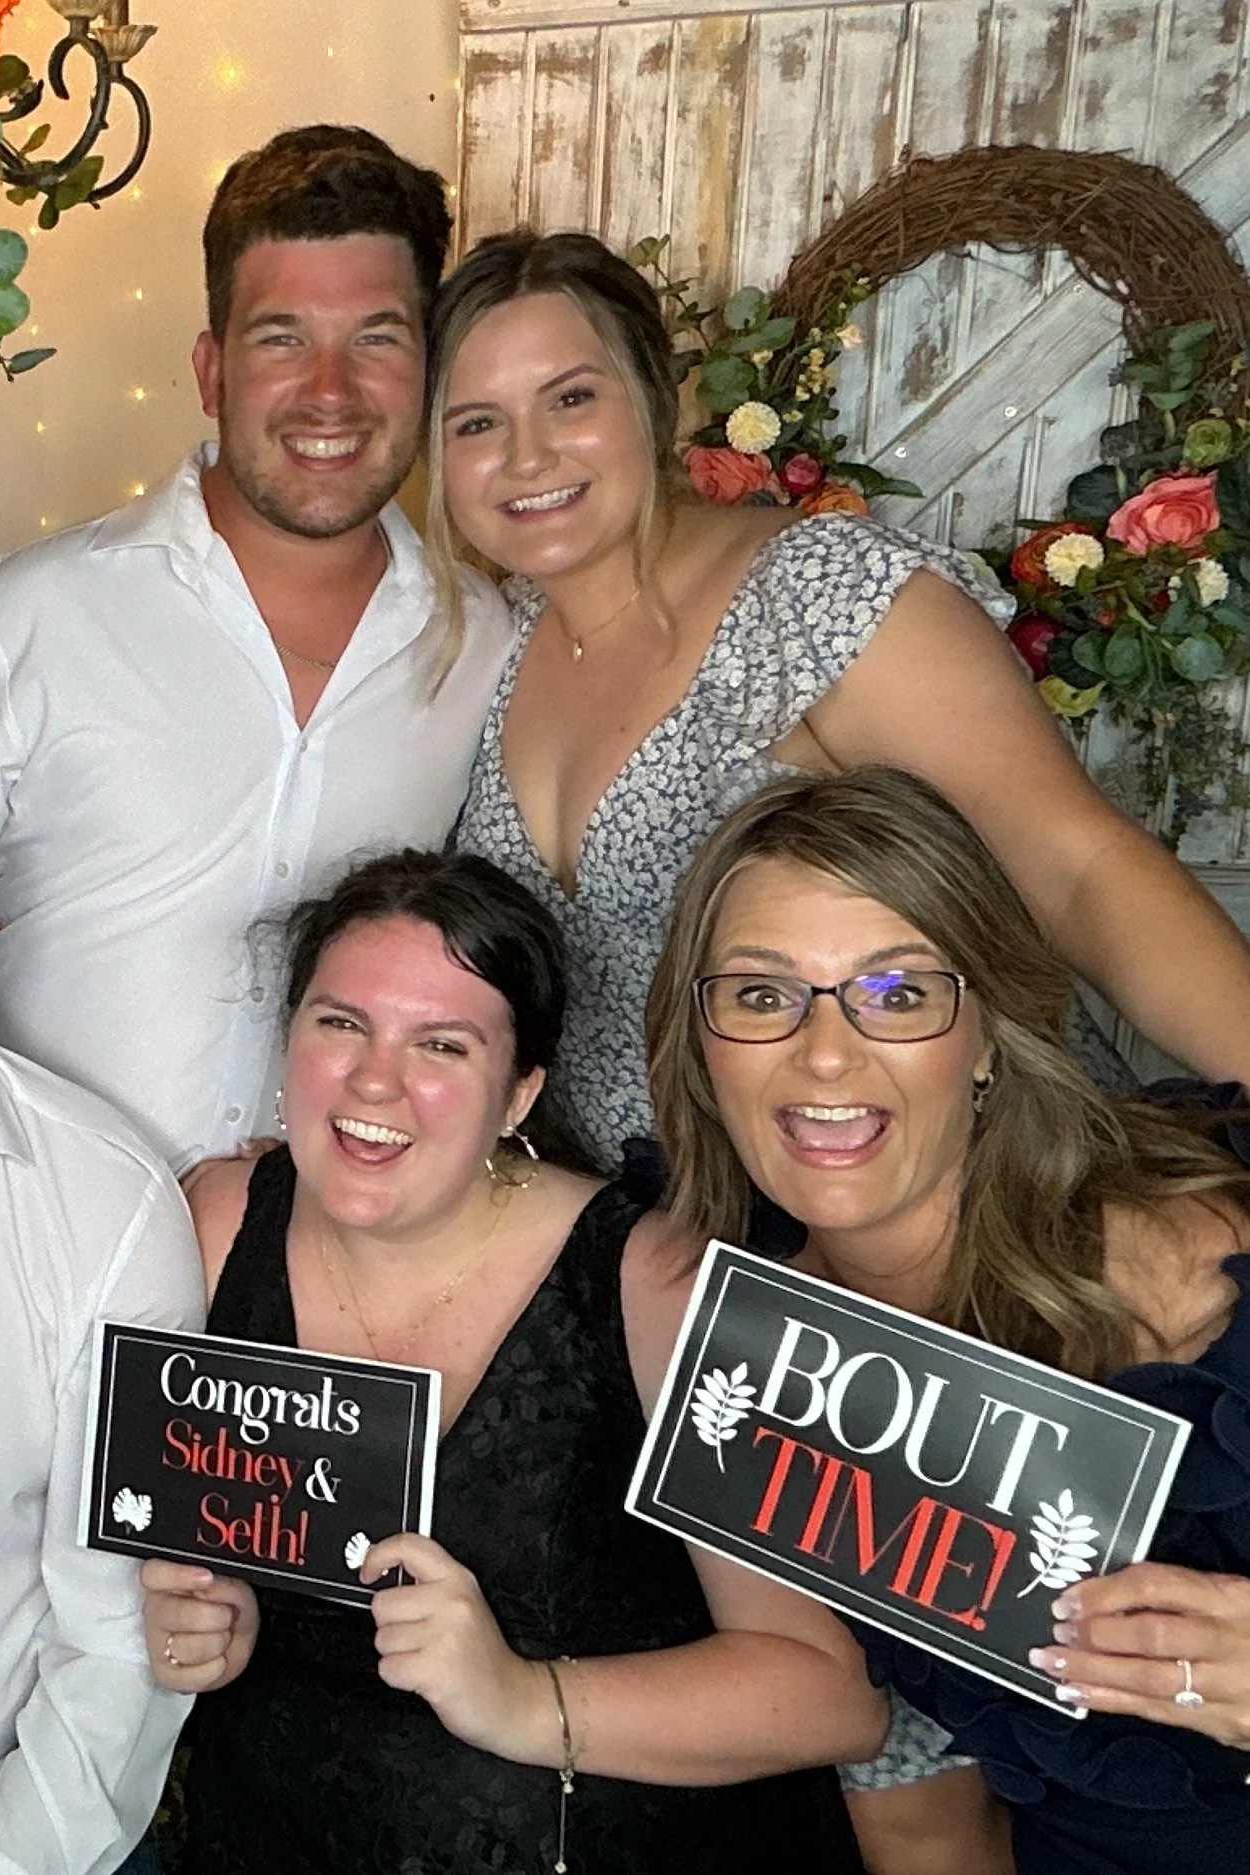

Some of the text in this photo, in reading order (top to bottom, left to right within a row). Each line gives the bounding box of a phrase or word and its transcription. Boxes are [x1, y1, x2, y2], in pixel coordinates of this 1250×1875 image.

[160, 1352, 361, 1445] Congrats
[753, 1316, 1069, 1516] BOUT
[161, 1418, 342, 1504] Sidney &
[196, 1492, 311, 1566] Seth!
[750, 1427, 1017, 1633] TIME!
